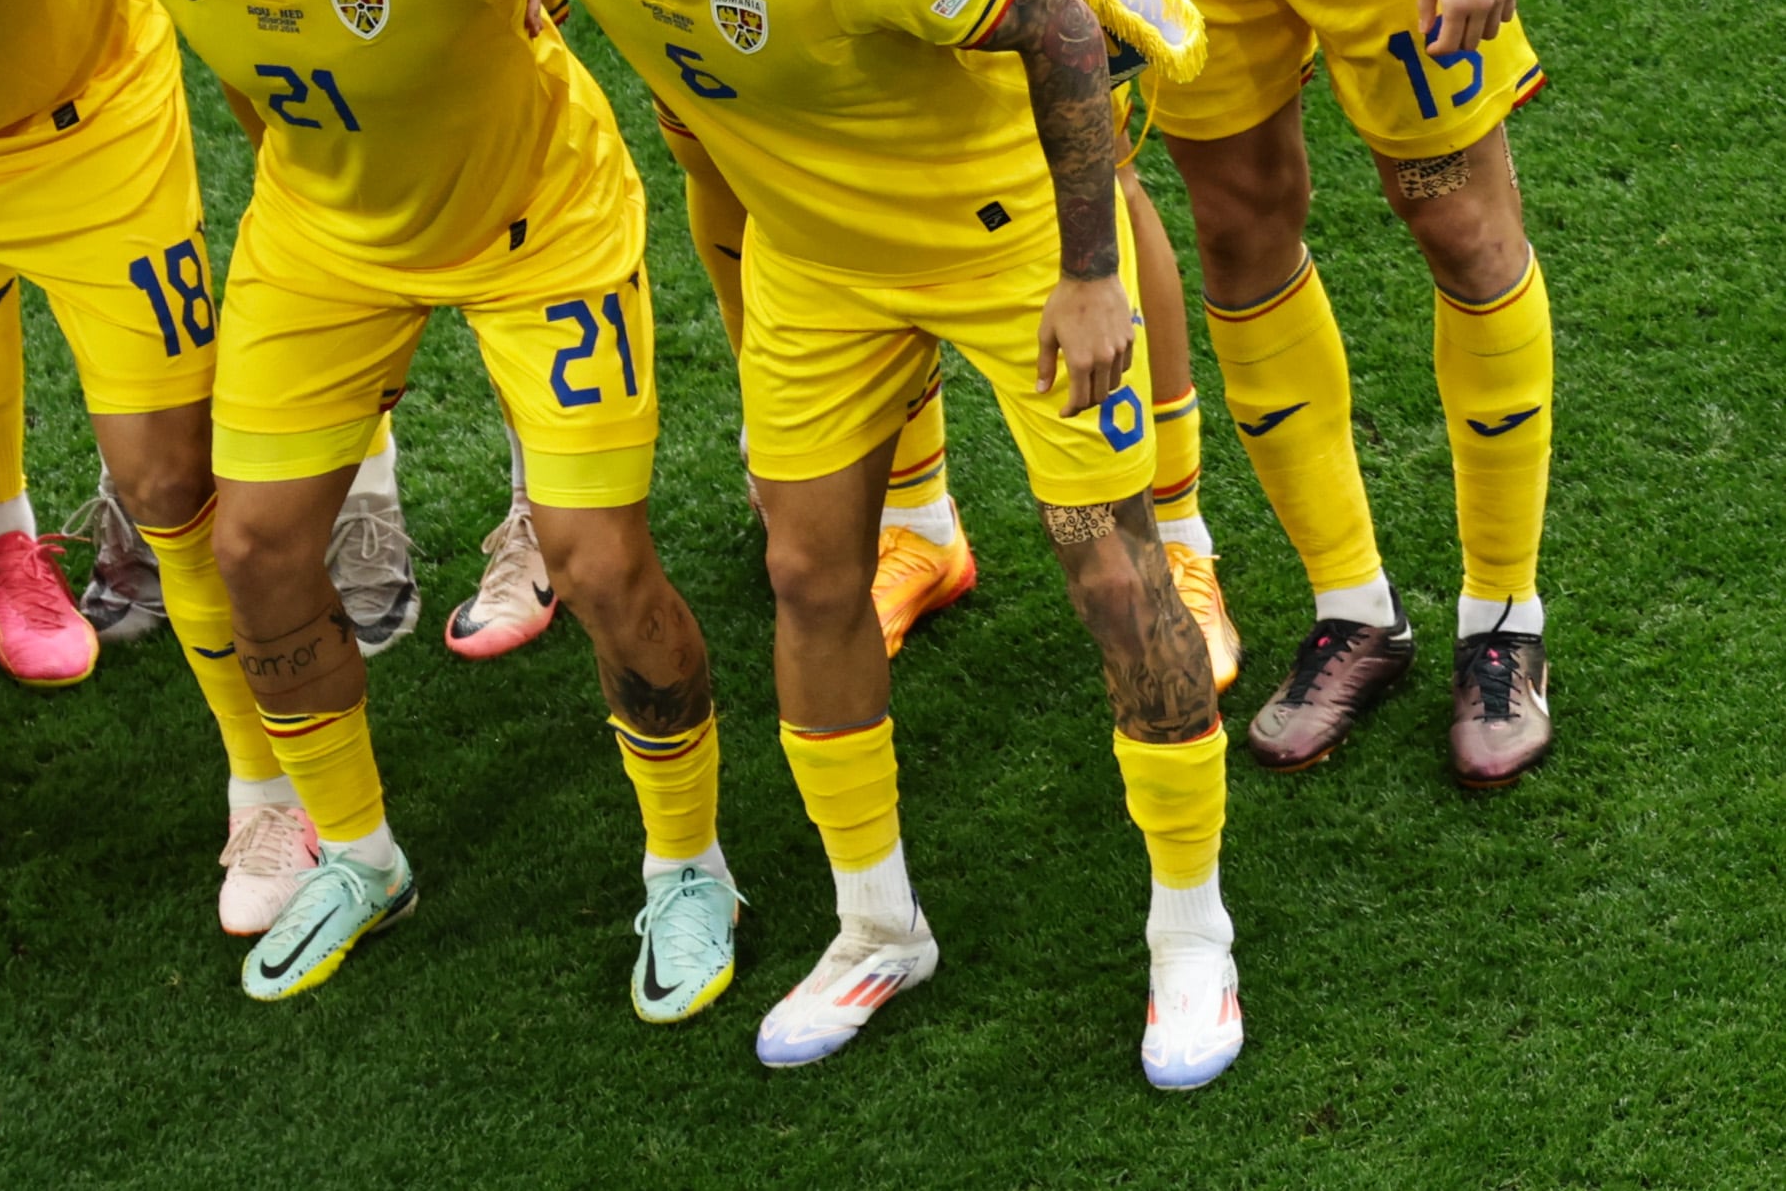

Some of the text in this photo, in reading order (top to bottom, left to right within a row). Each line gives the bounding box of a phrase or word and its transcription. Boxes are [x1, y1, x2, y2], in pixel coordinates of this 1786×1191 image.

[254, 63, 362, 133] 21
[666, 42, 737, 99] 6
[1387, 14, 1483, 119] 15
[129, 238, 216, 358] 18
[546, 291, 638, 408] 21
[243, 637, 323, 677] arrior
